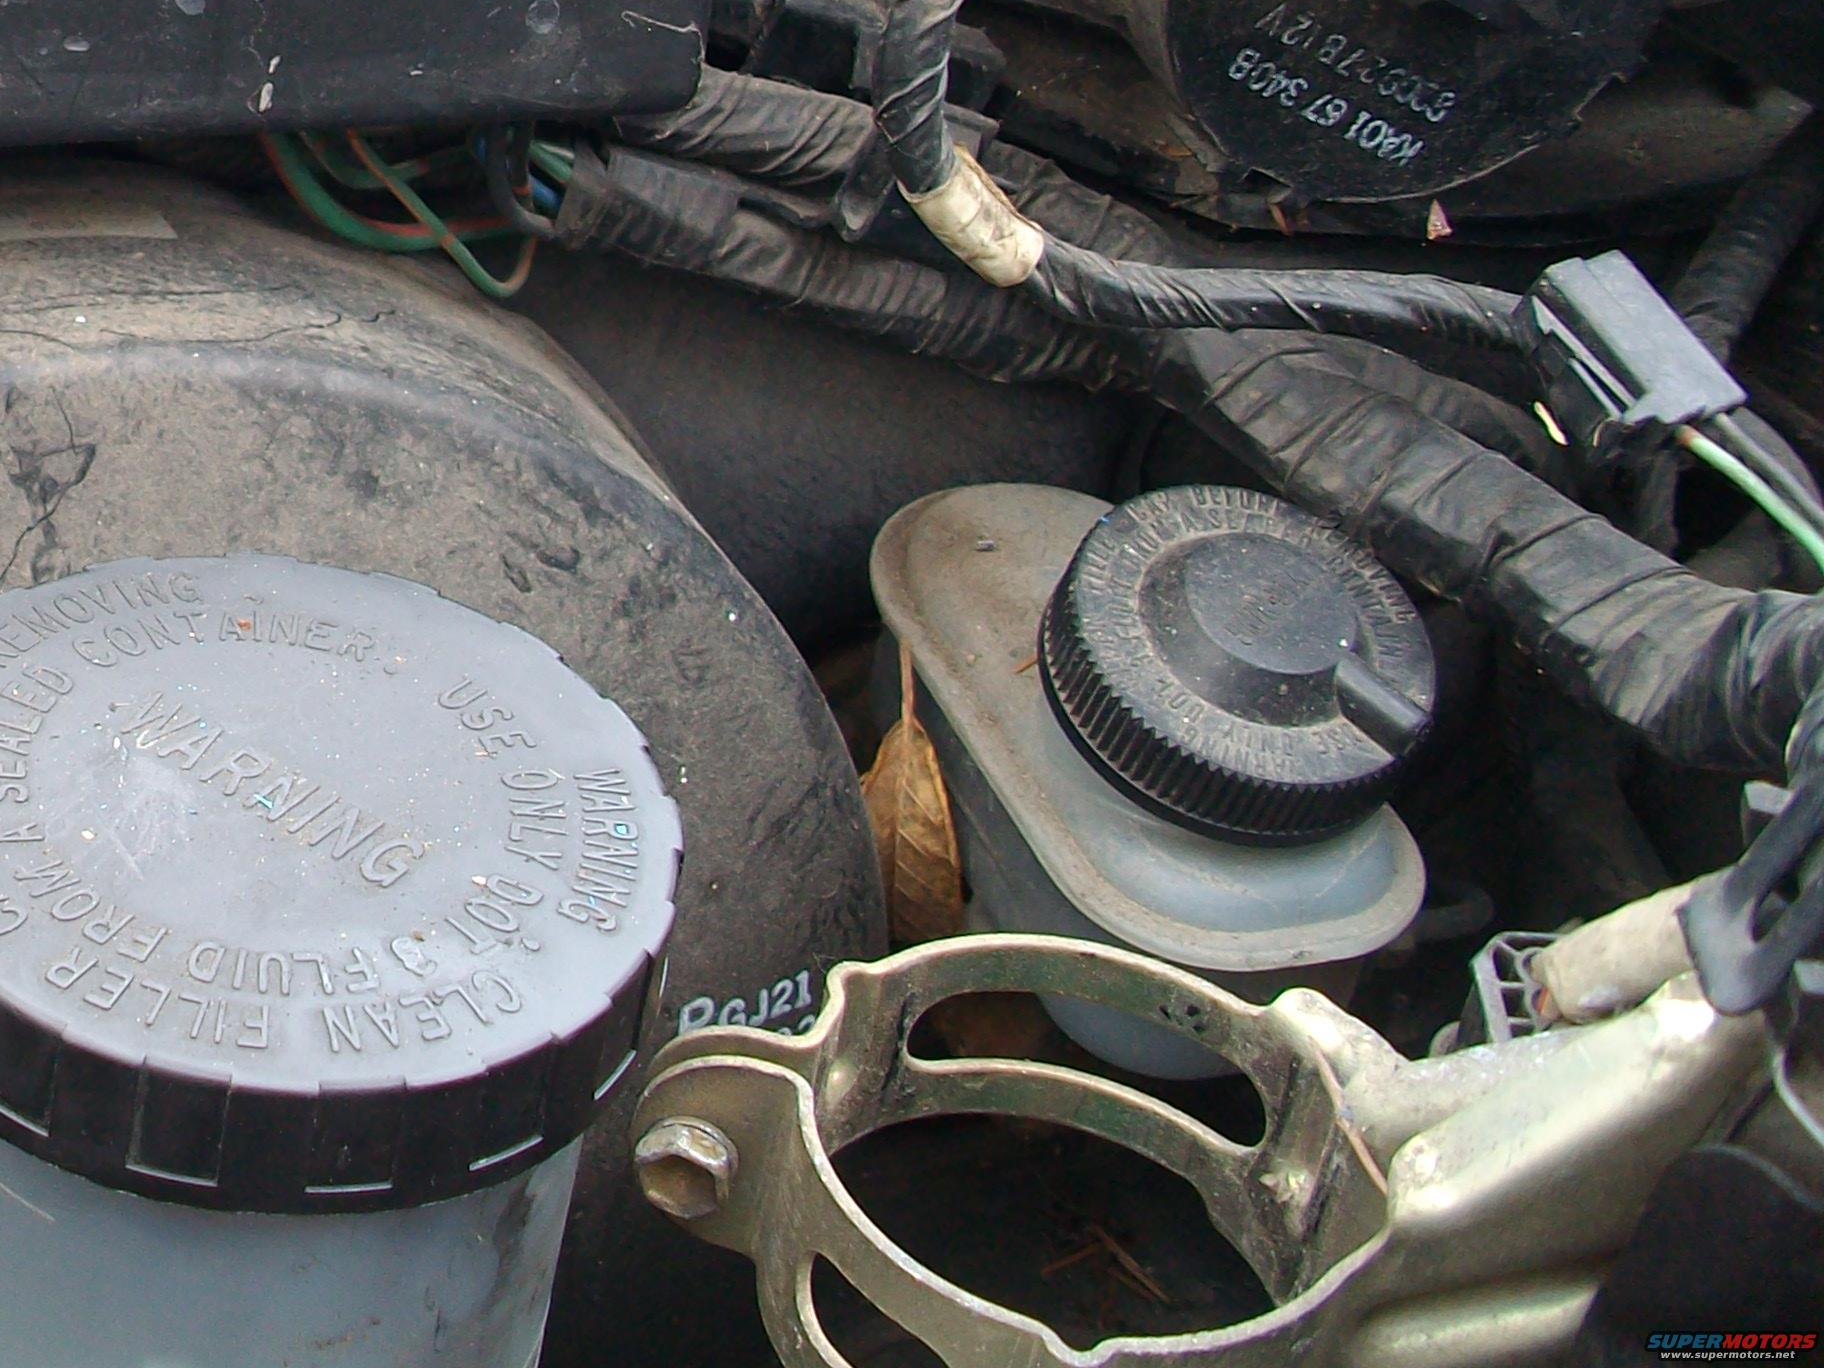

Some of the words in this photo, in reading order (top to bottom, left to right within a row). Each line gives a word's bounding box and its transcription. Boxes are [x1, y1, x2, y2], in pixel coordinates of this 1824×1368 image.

[437, 678, 538, 758] USE
[120, 692, 425, 889] WARNING
[500, 769, 569, 871] ONLY
[13, 860, 170, 963] FROM
[445, 874, 544, 955] DOT
[44, 946, 269, 1049] FILLER
[187, 941, 381, 996] FLUID
[322, 969, 523, 1053] CLEAN
